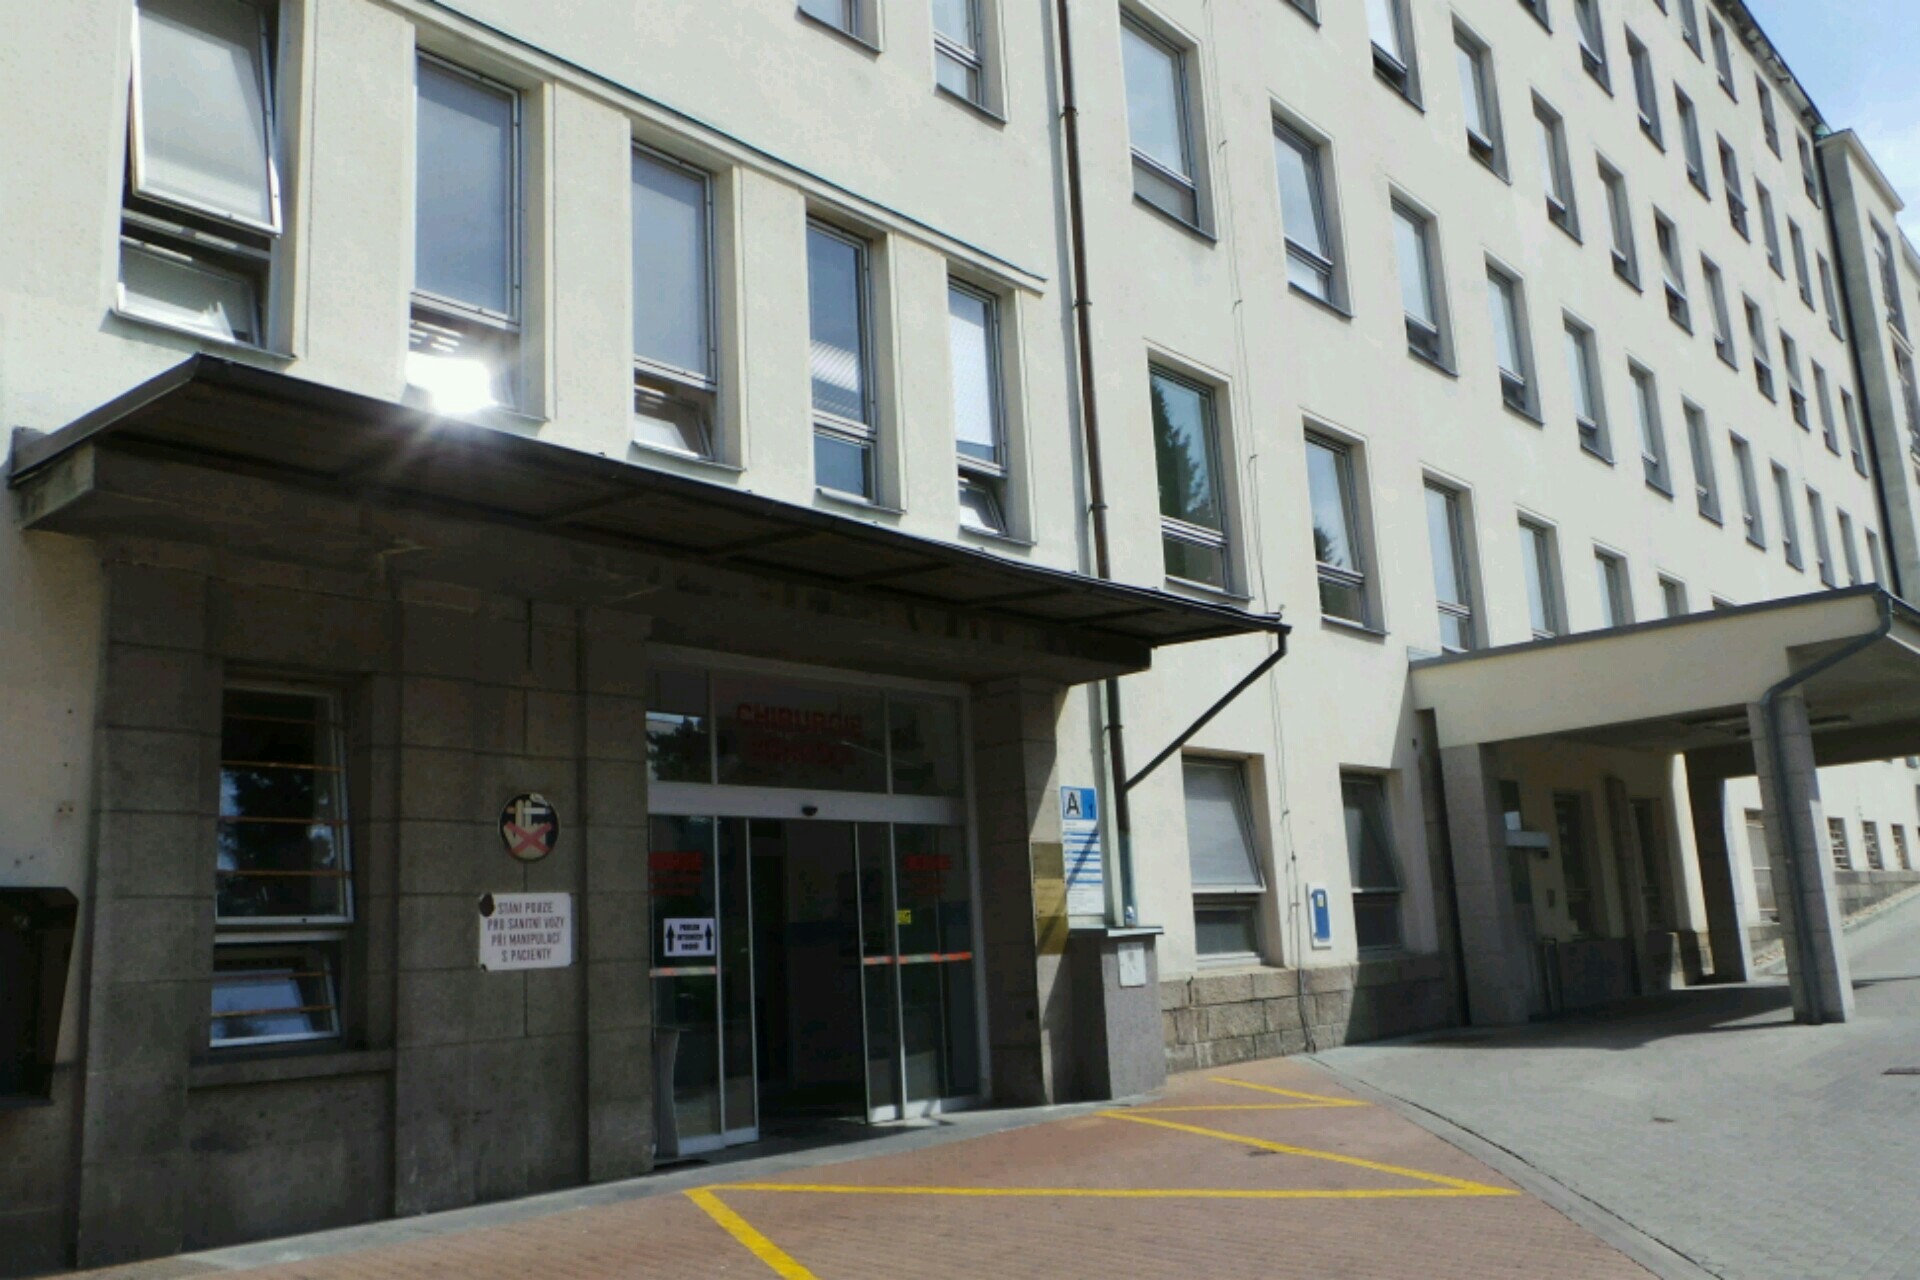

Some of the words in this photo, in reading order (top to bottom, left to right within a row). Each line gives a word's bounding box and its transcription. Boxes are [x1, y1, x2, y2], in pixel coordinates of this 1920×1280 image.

[736, 702, 863, 739] CHIRURGIE
[1066, 791, 1080, 815] A
[525, 901, 554, 914] POUZE
[487, 917, 504, 931] PRO
[501, 949, 508, 963] S
[511, 948, 551, 962] PACIENTY
